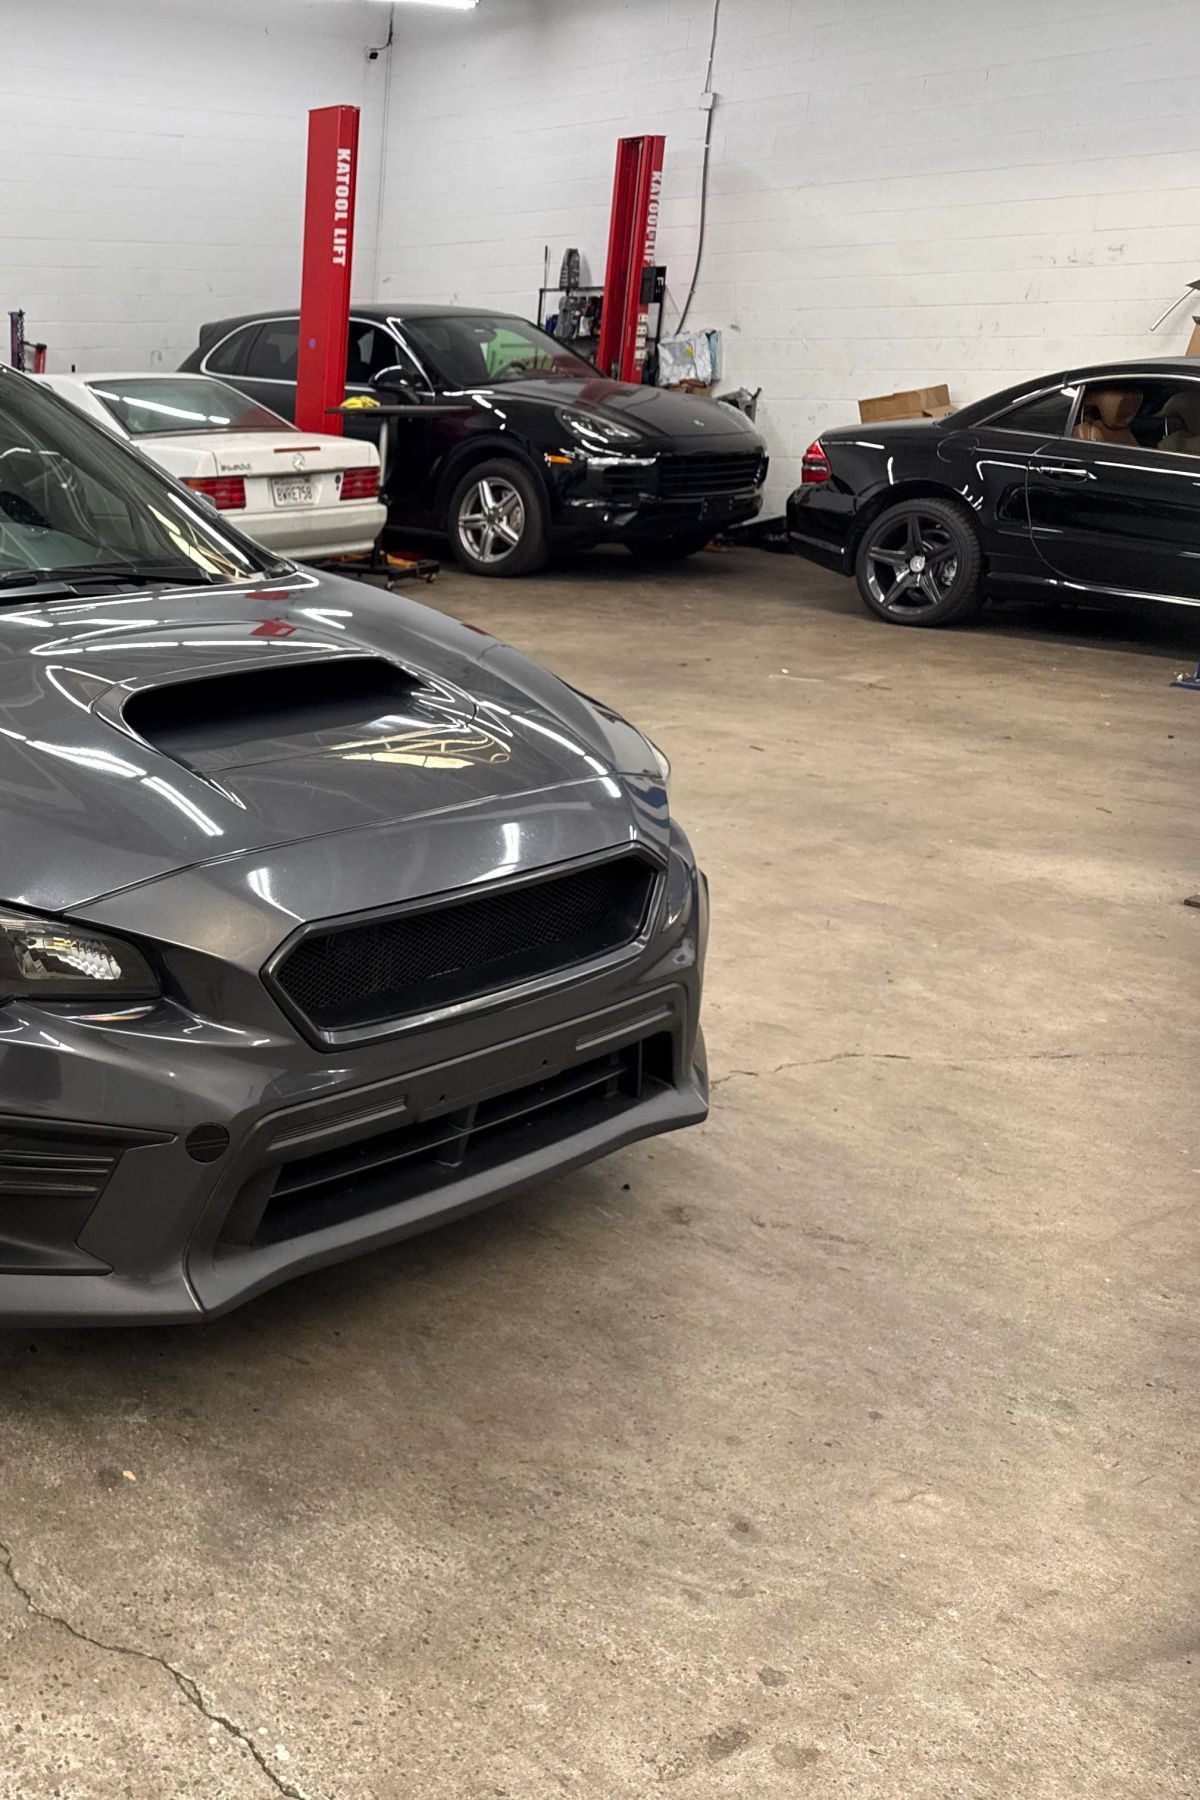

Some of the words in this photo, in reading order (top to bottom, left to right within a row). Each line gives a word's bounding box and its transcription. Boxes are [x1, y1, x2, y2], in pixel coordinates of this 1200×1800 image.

[335, 149, 351, 220] KATOOL
[333, 228, 347, 266] LIFT
[643, 240, 656, 266] LIF
